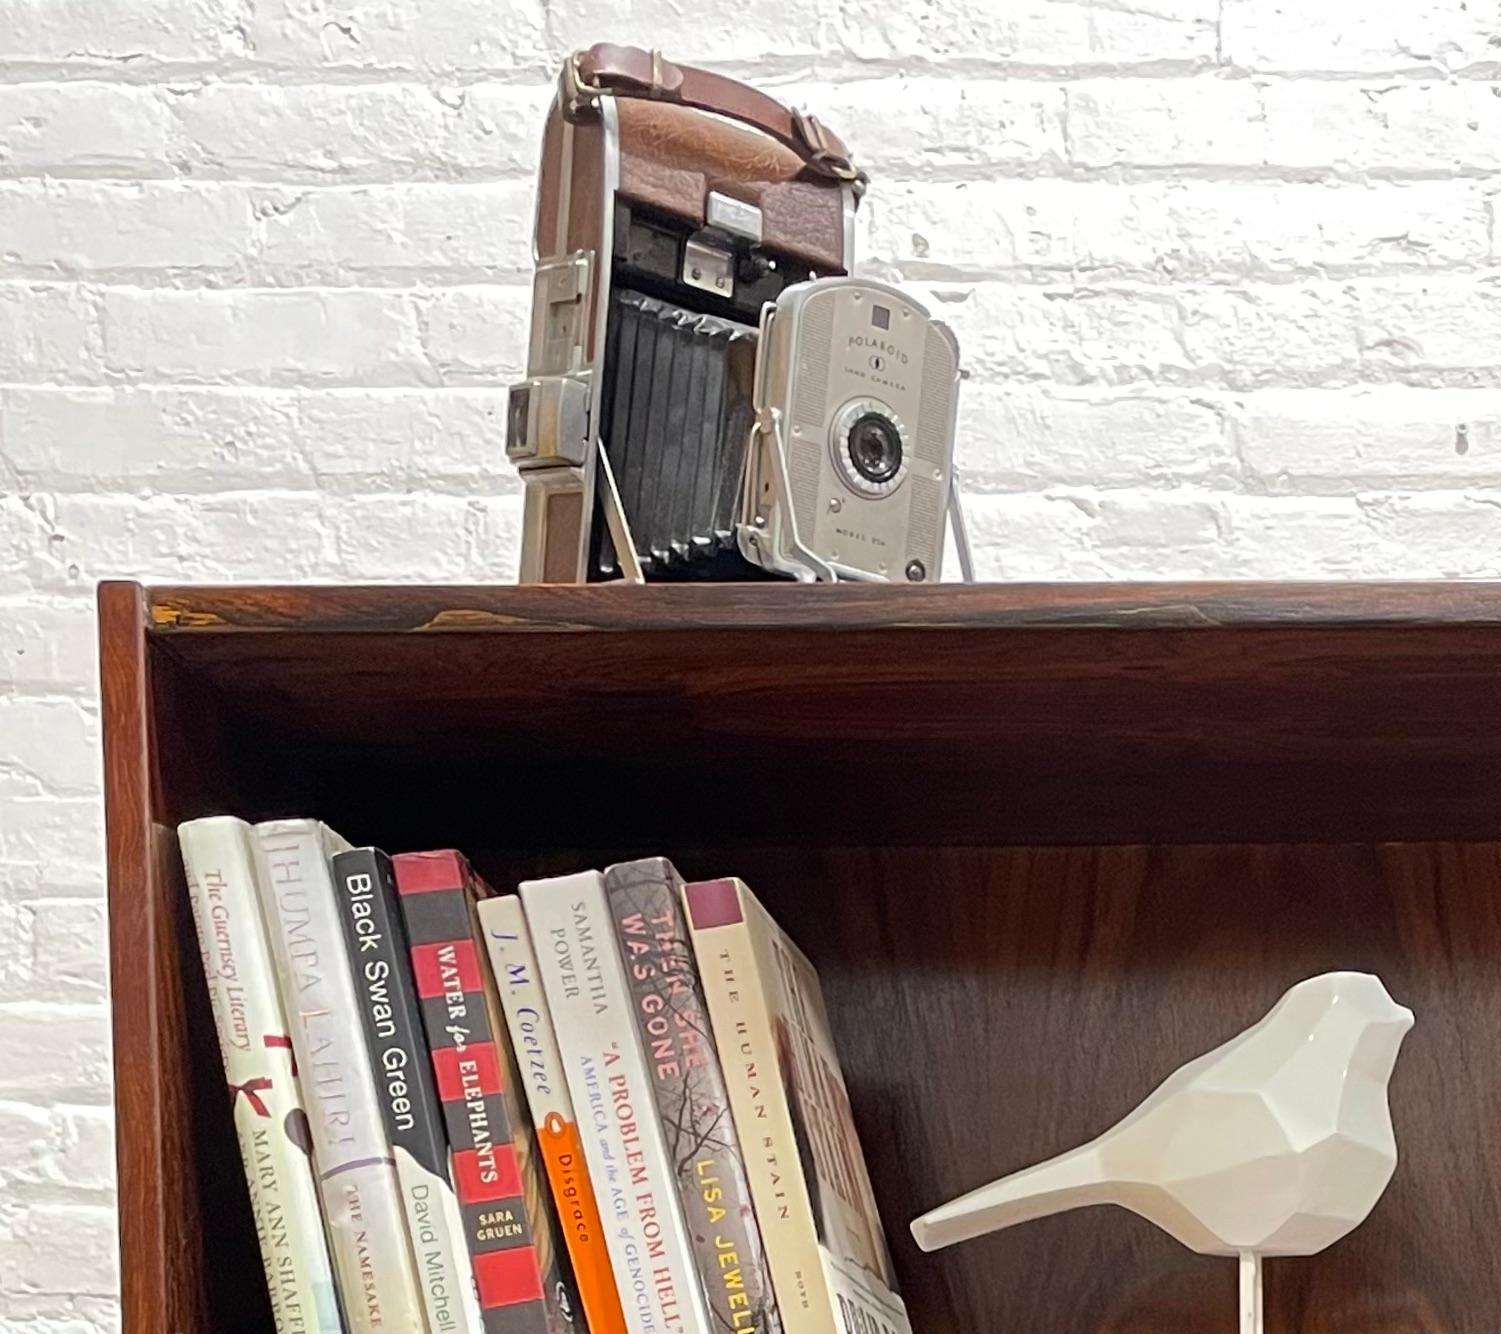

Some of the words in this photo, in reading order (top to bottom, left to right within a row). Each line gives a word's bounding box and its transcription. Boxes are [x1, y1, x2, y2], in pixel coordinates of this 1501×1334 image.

[847, 335, 909, 365] POLAROID
[204, 868, 227, 902] The
[211, 904, 238, 984] Guernsey
[503, 963, 531, 997] M.
[550, 927, 581, 999] POWER
[571, 901, 609, 1016] SAMANTHA
[226, 985, 252, 1053] Literary
[257, 828, 323, 996] JHUMPA
[299, 1006, 357, 1147] LAHIRI
[345, 872, 383, 953] Black
[364, 960, 397, 1038] Swan
[381, 1046, 415, 1132] Green
[621, 911, 657, 982] WAS
[640, 992, 682, 1081] GONE
[651, 908, 690, 996] THEN
[674, 1009, 708, 1070] SHE
[436, 944, 468, 1021] WATER
[458, 1058, 499, 1186] ELEPHANTS
[516, 1006, 552, 1095] Coetzee
[719, 950, 740, 1005] THE
[735, 1020, 768, 1120] HUMAN
[762, 1136, 791, 1221] STAIN
[252, 1128, 279, 1193] MARY
[580, 1055, 609, 1134] AMERICA
[611, 1186, 629, 1223] AGE
[608, 1073, 651, 1188] PROBLEM
[635, 1191, 667, 1261] FROM
[265, 1201, 290, 1250] ANN
[410, 1183, 439, 1245] David
[476, 1223, 523, 1242] GRUEN
[478, 1210, 514, 1226] SARA
[558, 1153, 589, 1244] Disgrace
[696, 1158, 727, 1225] LISA
[346, 1184, 362, 1223] THE
[354, 1230, 383, 1329] NAMESAKE
[423, 1250, 457, 1333] Mitchell
